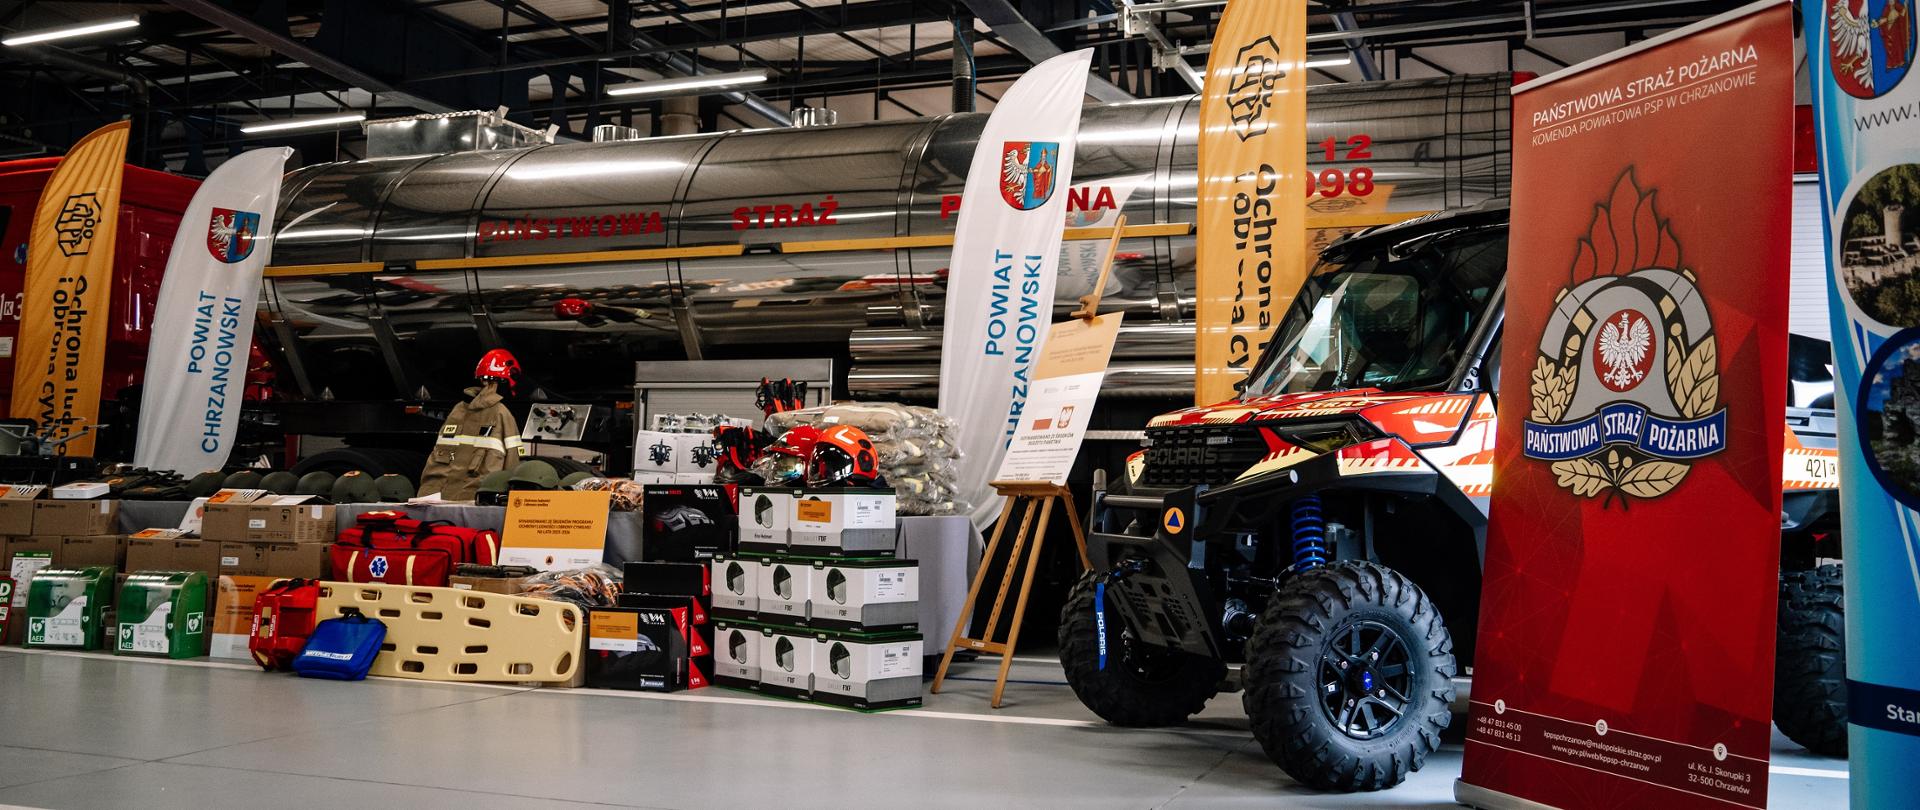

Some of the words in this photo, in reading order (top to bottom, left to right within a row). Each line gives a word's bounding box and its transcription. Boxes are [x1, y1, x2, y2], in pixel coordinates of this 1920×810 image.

[1532, 86, 1622, 127] PAŃSTWOWA
[1626, 66, 1675, 98] STRAŻ
[1679, 45, 1758, 83] POŻARNA
[1532, 124, 1578, 147] KOMENDA
[1579, 106, 1643, 134] POWIATOWA
[1643, 99, 1664, 115] PSP
[1666, 96, 1677, 109] W
[1679, 71, 1757, 106] CHRZANOWIE
[1854, 101, 1920, 132] www.
[478, 211, 666, 243] PAŃSTWOWA
[731, 195, 839, 231] STRAŻ
[1253, 163, 1277, 330] Ochrona
[985, 249, 1013, 356] POWIAT
[65, 275, 88, 381] Ochrona
[188, 290, 216, 373] POWIAT
[201, 297, 242, 453] CHRZANOWSKI
[1005, 255, 1042, 450] HRZANOWSKI
[1527, 423, 1599, 453] PAŃSTWOWA
[1604, 410, 1641, 437] STRAŻ
[1649, 423, 1720, 452] POŻARNA
[1147, 446, 1218, 465] POLARIS
[1806, 458, 1827, 478] 421
[1097, 612, 1105, 655] POLARIS
[1496, 720, 1505, 728] 831
[1506, 722, 1514, 730] 45
[1514, 724, 1522, 732] 00
[1505, 732, 1513, 740] 45
[1514, 734, 1521, 742] 13
[1688, 762, 1697, 770] ul.
[1715, 767, 1745, 780] Skorupki
[1745, 774, 1751, 782] 3
[1688, 773, 1714, 786] 32-500
[1714, 779, 1750, 794] Chrzanów
